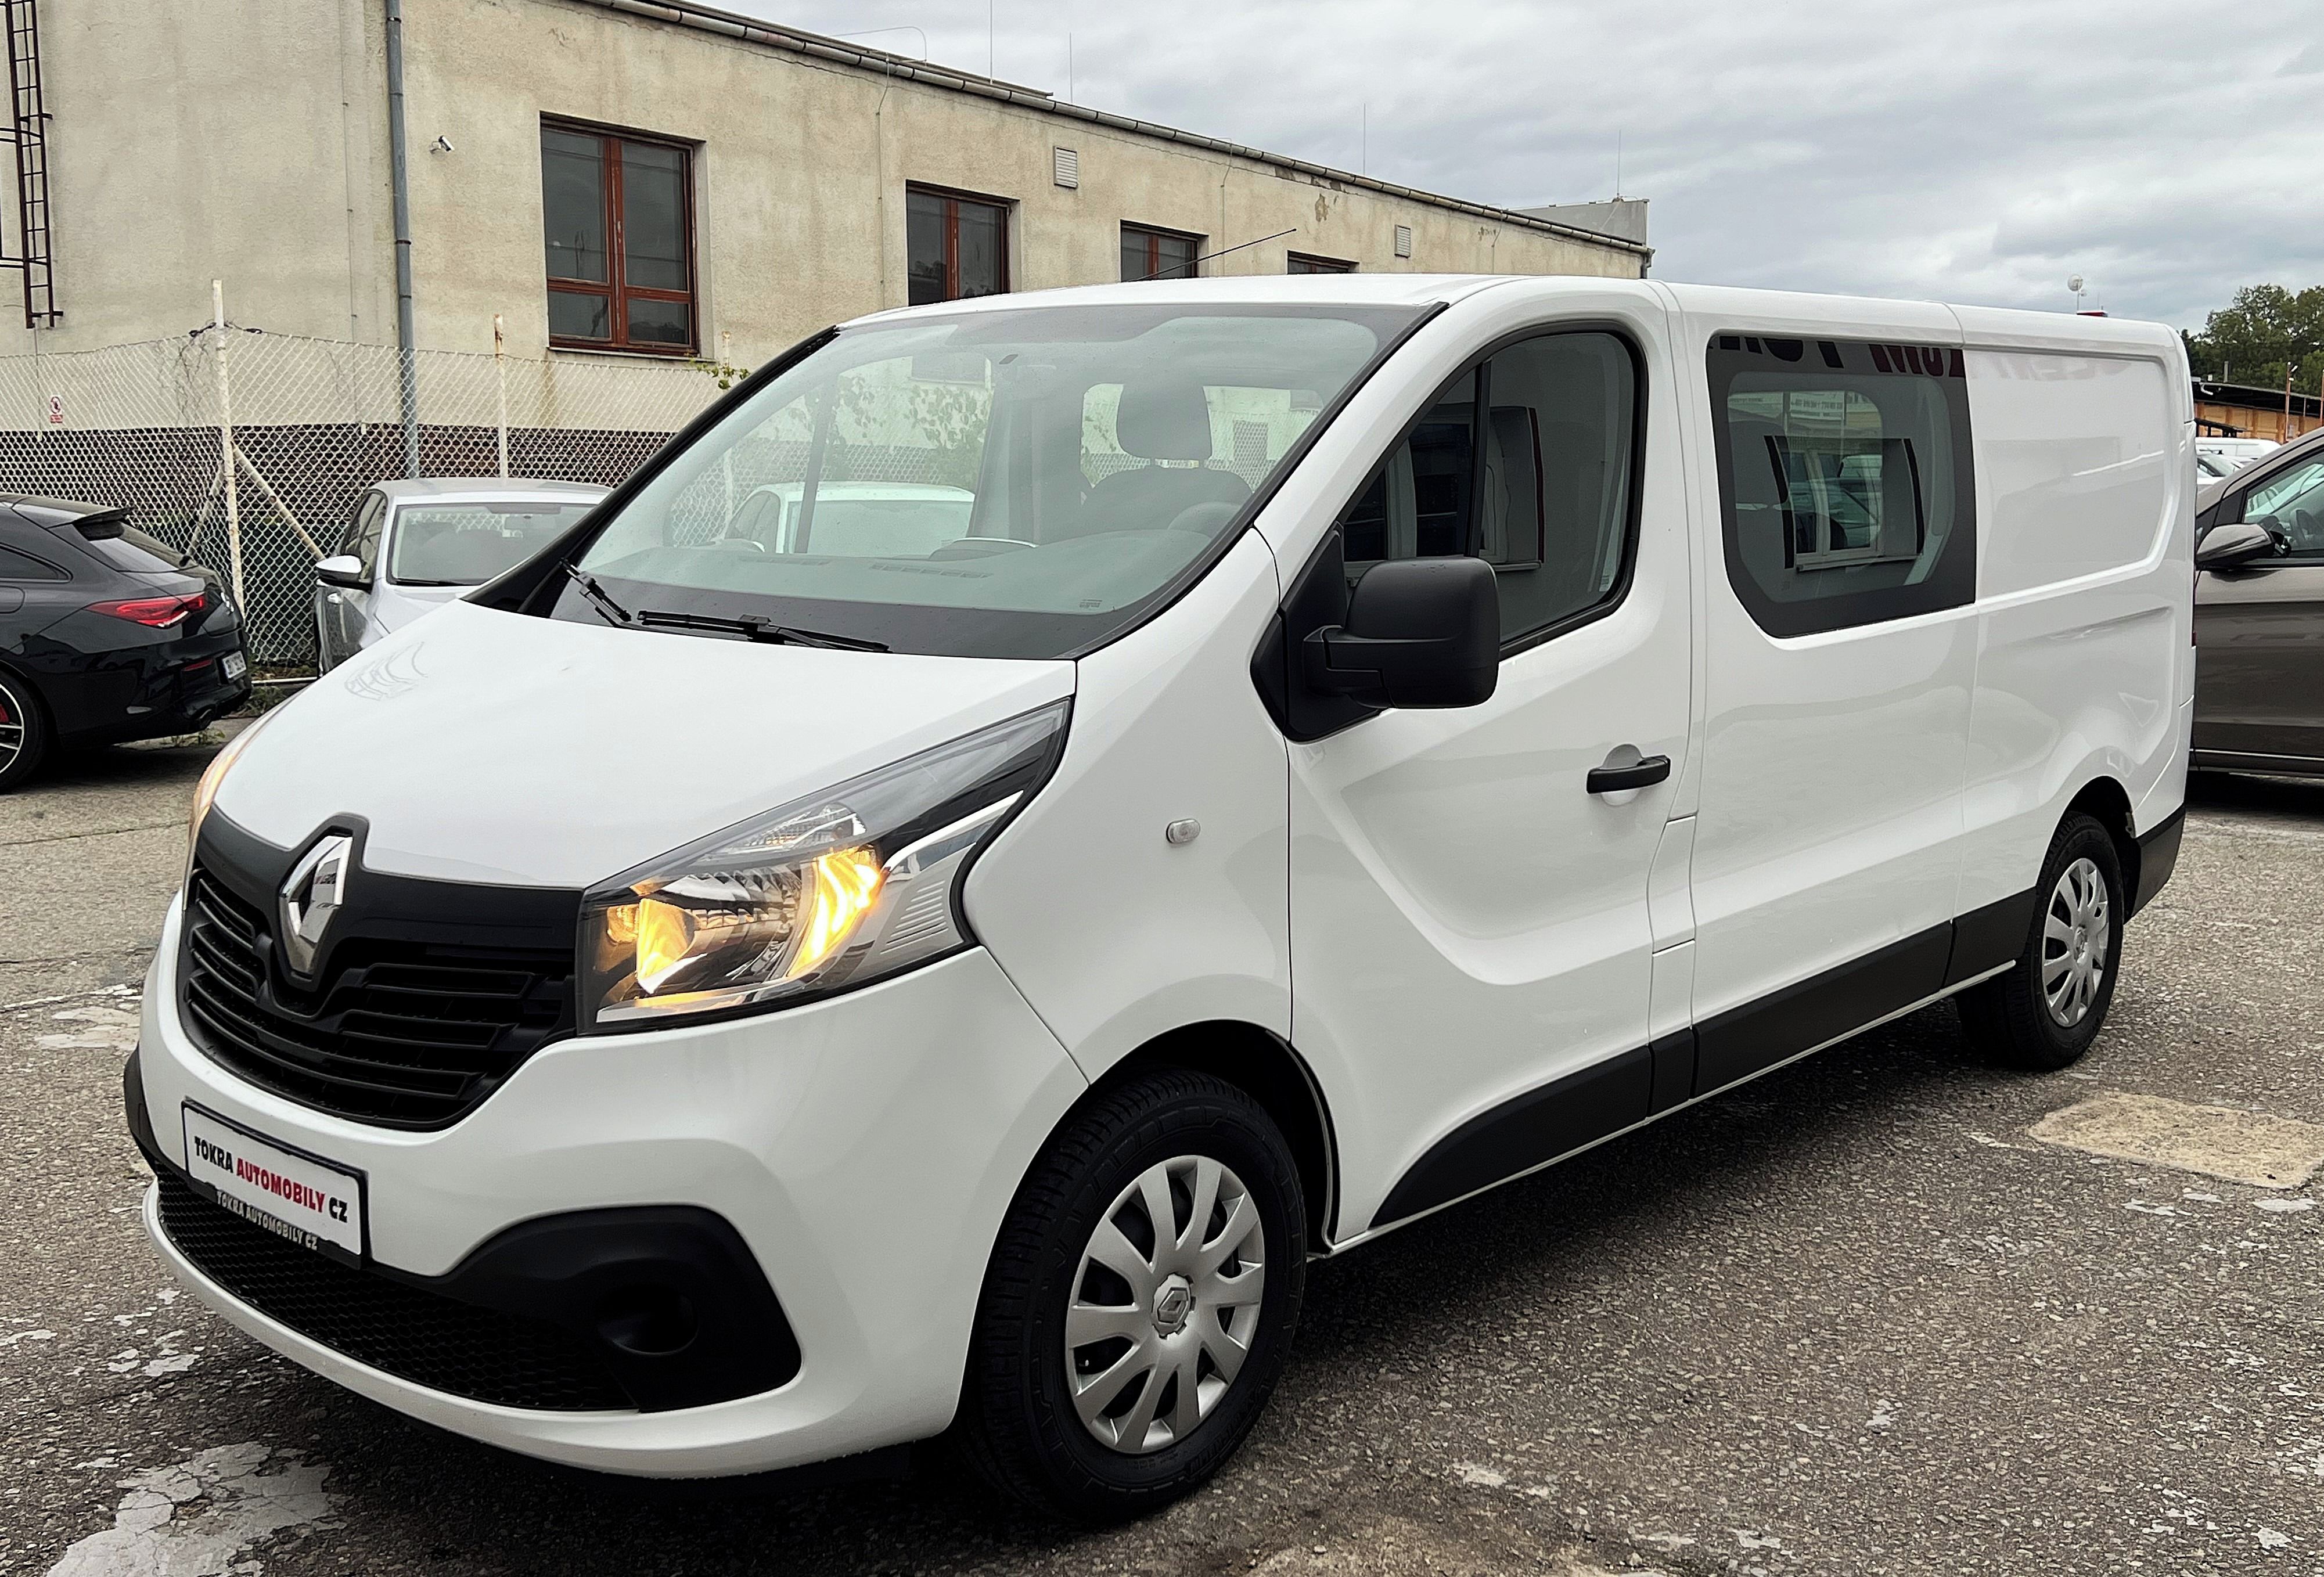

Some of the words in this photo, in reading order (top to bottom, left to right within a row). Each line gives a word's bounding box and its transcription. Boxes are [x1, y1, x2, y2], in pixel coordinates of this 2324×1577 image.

[195, 1136, 233, 1173] TOKRA
[236, 1157, 325, 1213] AUTOMOBILY
[329, 1197, 348, 1223] CZ
[217, 1191, 244, 1217] TOKRA
[246, 1206, 303, 1244] AUTOMOBILY
[305, 1234, 318, 1250] CZ
